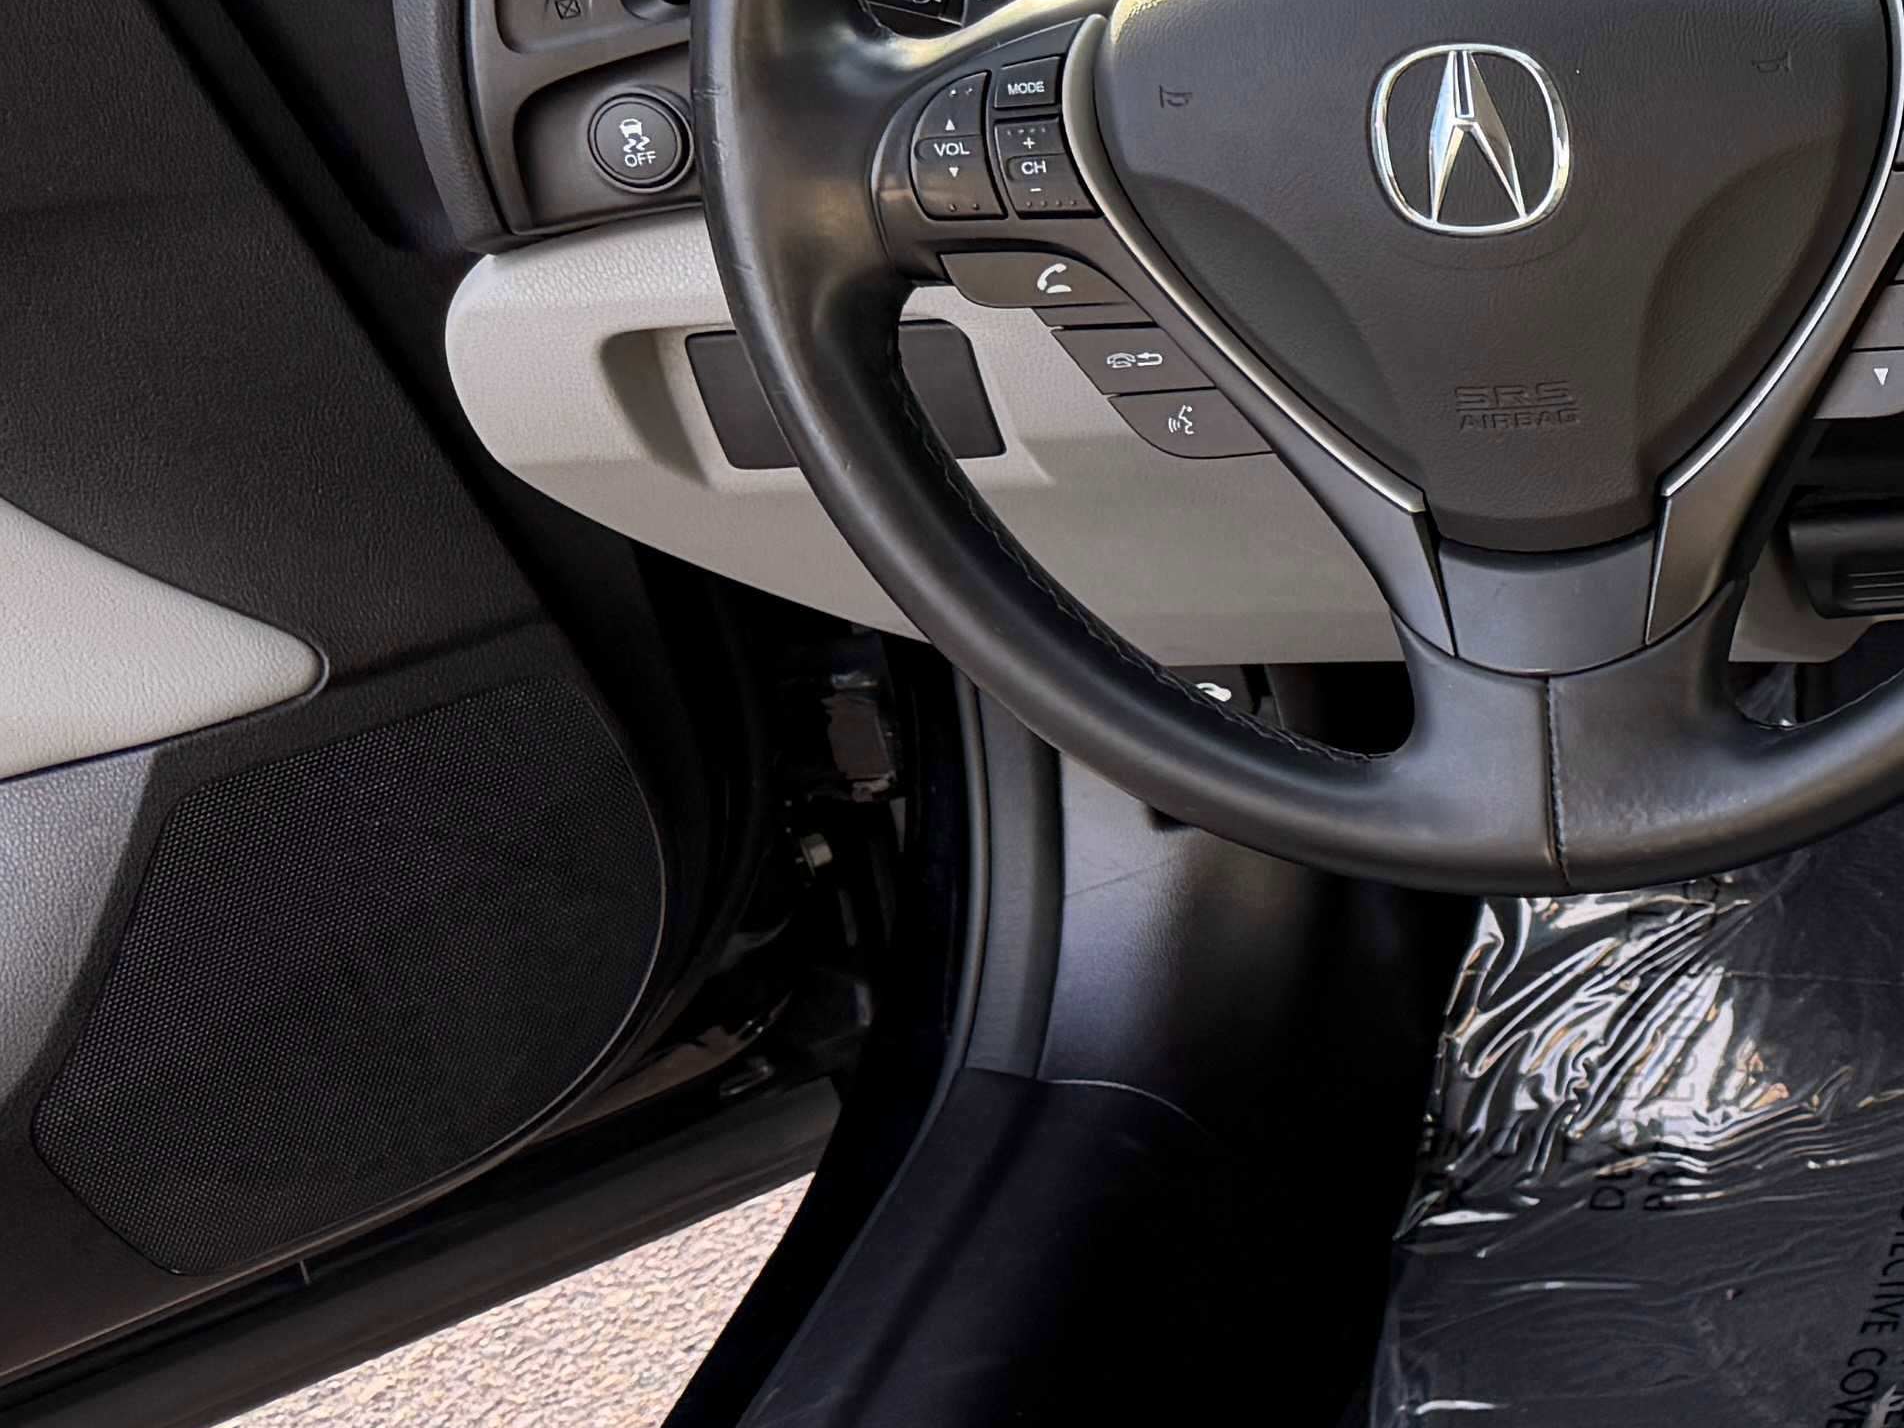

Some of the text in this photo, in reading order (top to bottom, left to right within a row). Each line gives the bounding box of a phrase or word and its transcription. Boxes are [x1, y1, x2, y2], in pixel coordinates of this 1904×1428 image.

[1007, 80, 1046, 96] MODE
[933, 141, 971, 157] VOL
[624, 150, 657, 168] OFF
[1020, 159, 1047, 175] CH
[1454, 380, 1572, 406] SRS
